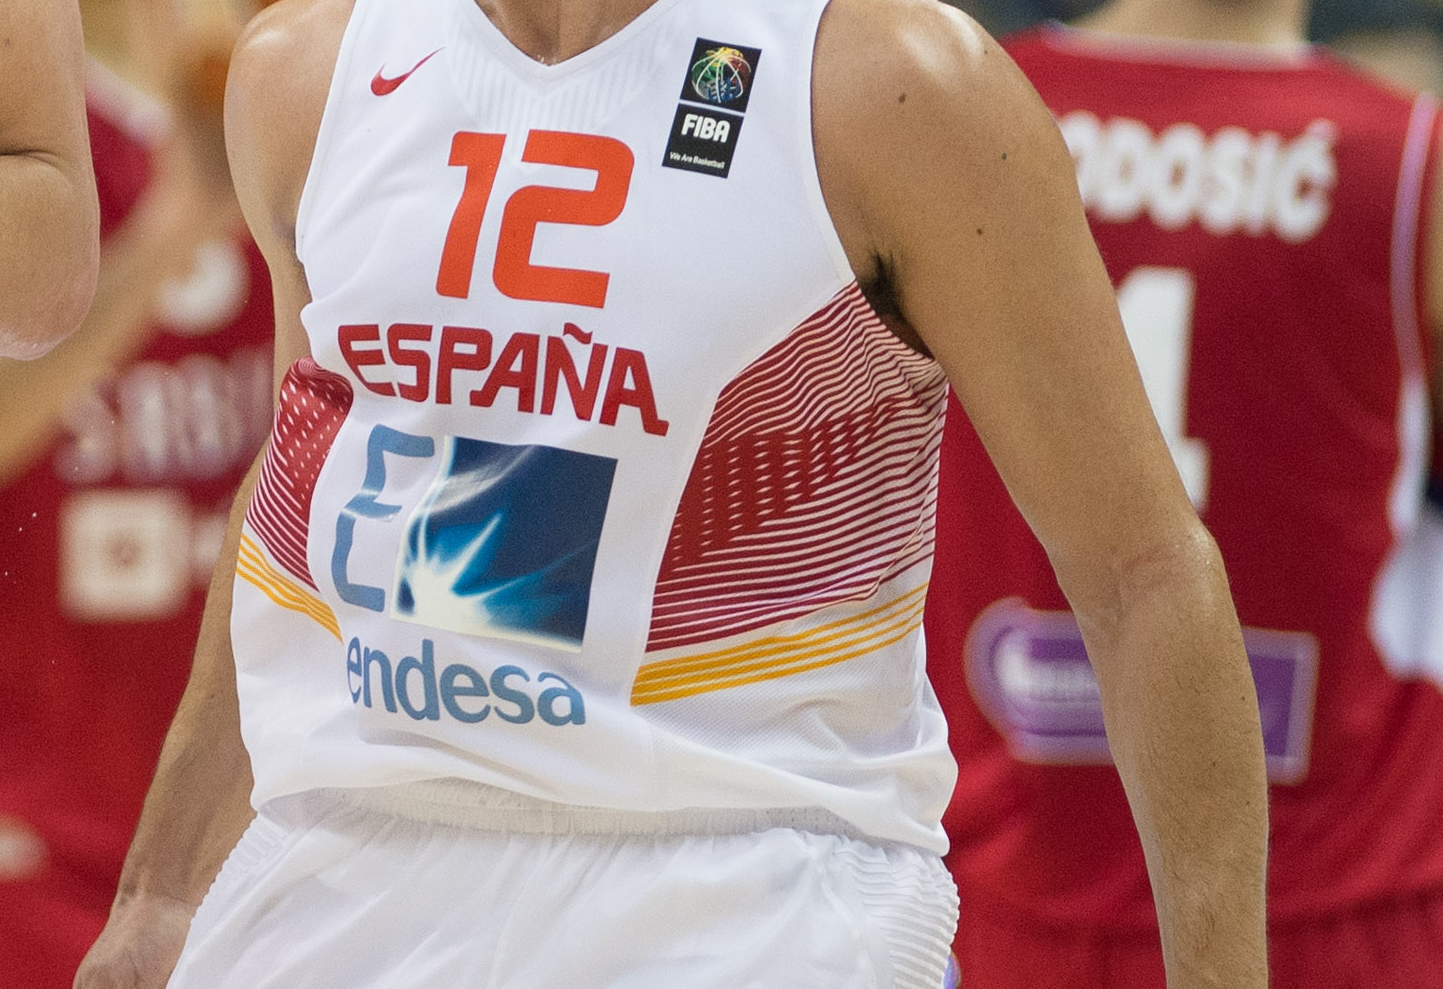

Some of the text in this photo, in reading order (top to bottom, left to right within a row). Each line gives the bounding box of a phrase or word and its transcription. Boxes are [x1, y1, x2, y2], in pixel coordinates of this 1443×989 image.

[681, 113, 731, 143] FIBA
[436, 129, 635, 309] 12
[338, 322, 670, 437] ESPAÑA
[347, 636, 586, 726] endesa
